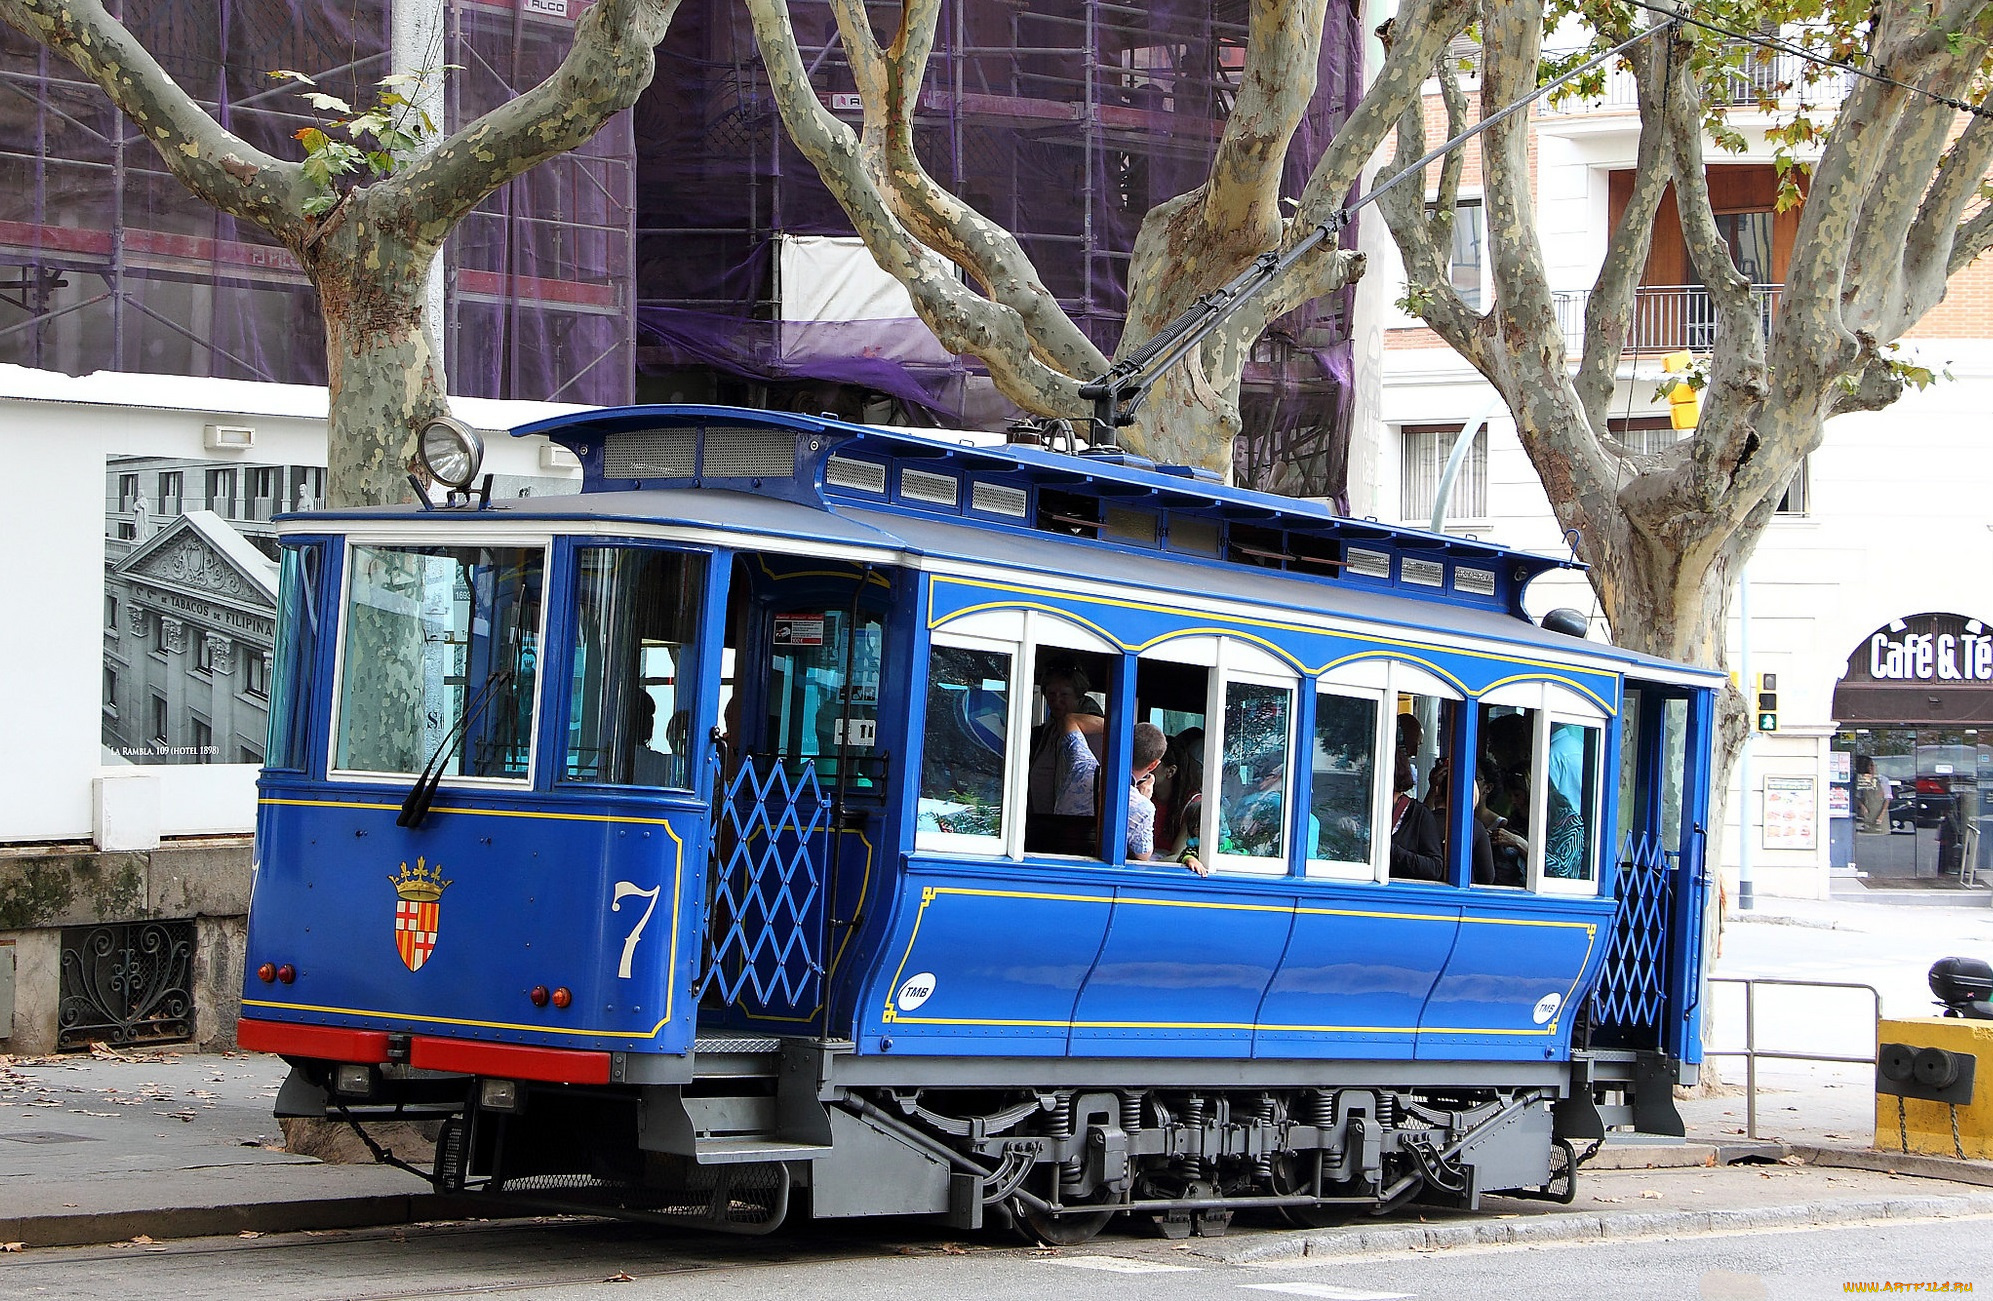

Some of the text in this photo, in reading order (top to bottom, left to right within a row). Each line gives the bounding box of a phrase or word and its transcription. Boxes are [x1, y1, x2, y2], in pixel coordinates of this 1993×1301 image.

[531, 0, 565, 13] ALCO
[171, 595, 209, 617] TABACOS
[1870, 632, 1993, 680] Café & Té
[156, 746, 169, 755] 109
[170, 746, 198, 756] (HOTEL
[200, 745, 220, 756] 1898)
[611, 881, 661, 979] 7
[904, 986, 930, 998] TMB
